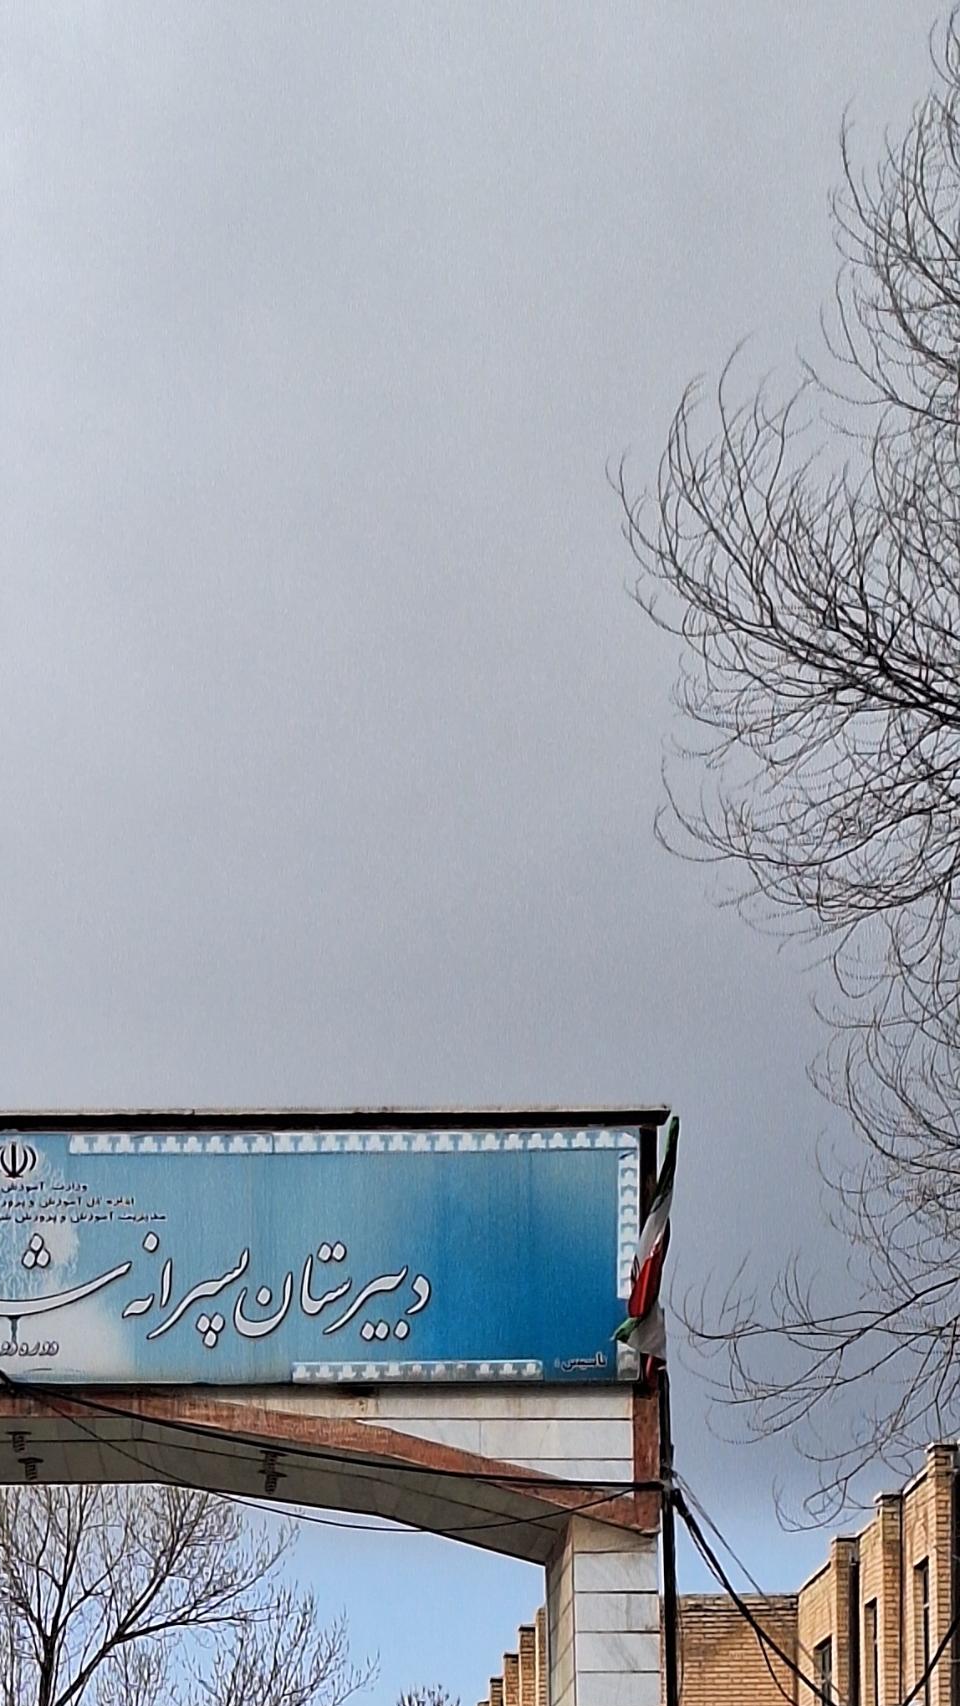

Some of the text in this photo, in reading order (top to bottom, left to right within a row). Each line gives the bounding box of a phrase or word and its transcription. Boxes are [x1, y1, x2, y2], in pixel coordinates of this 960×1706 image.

[1, 1181, 44, 1194] آموزش
[39, 1196, 82, 1208] آموزش
[122, 1230, 251, 1349] پسرانه
[234, 1241, 432, 1342] دبیرستان
